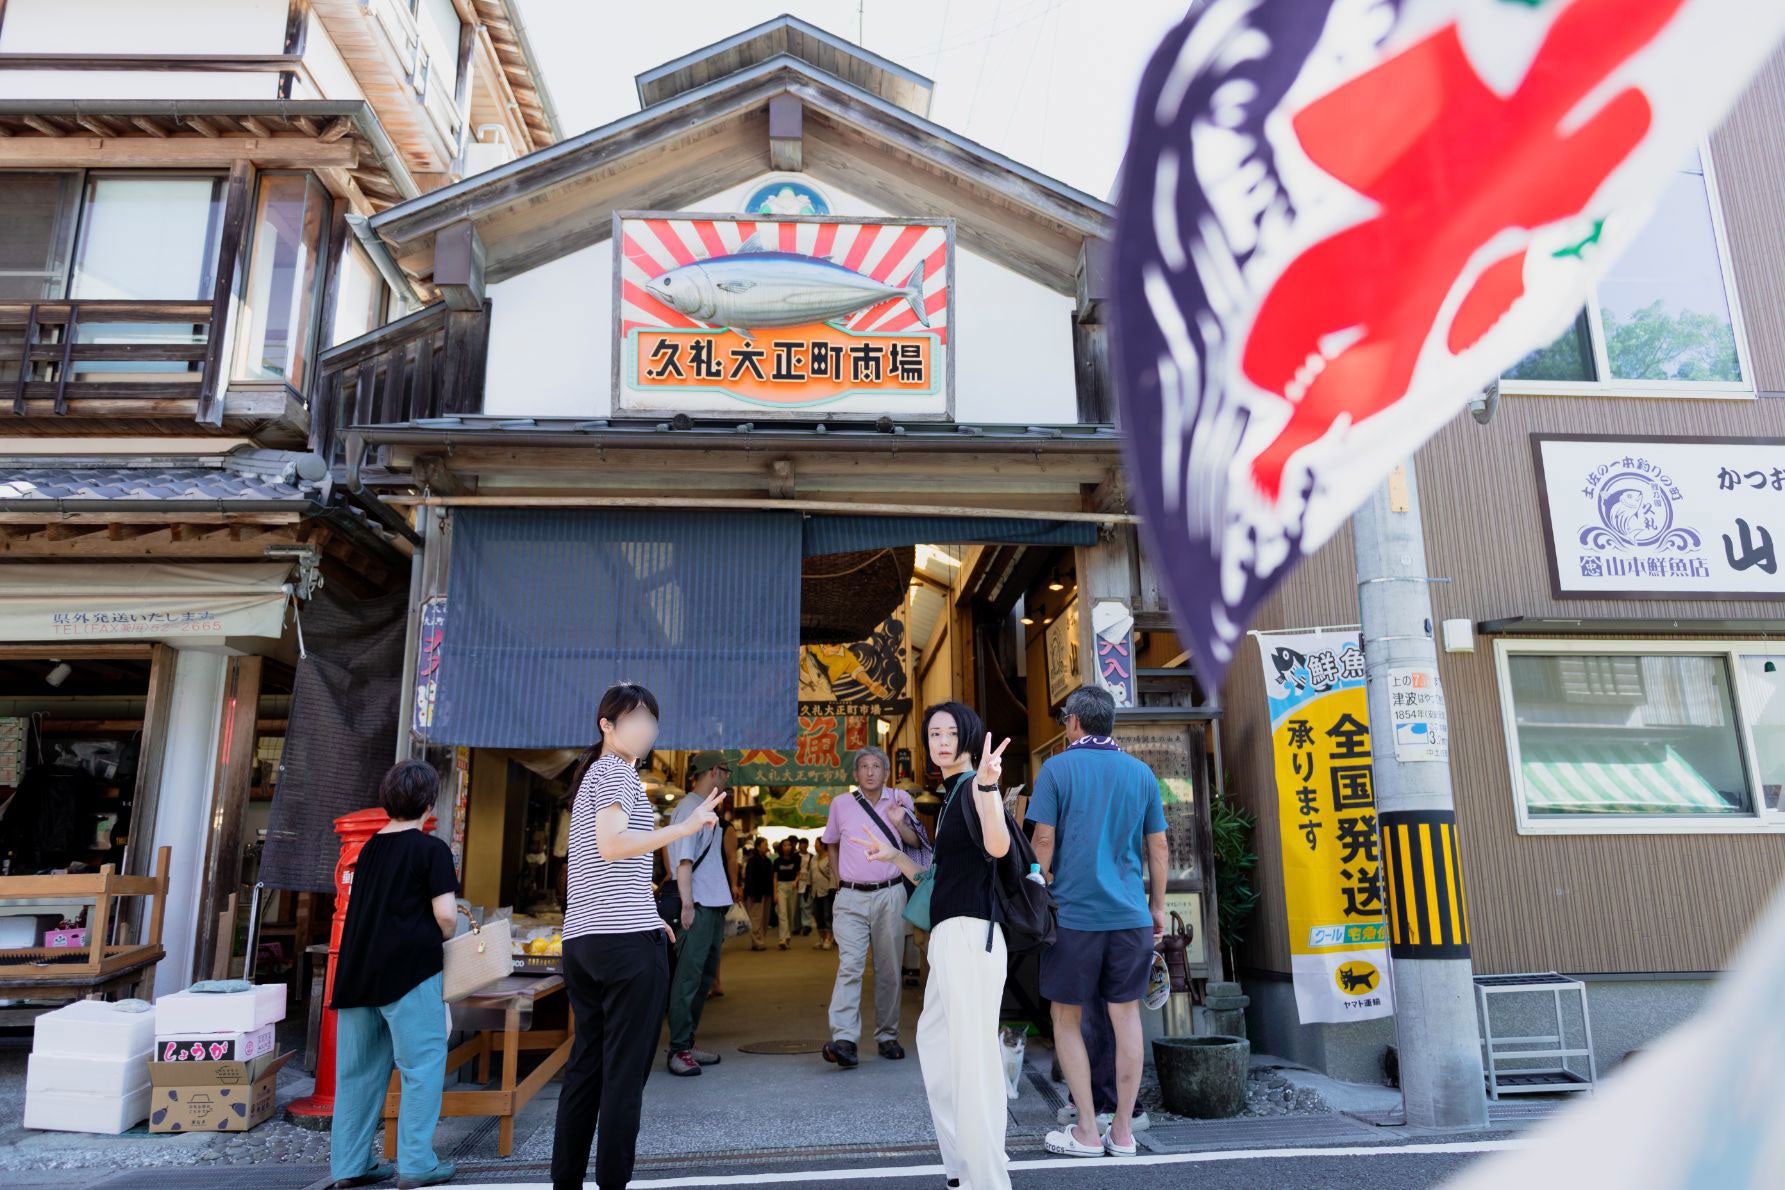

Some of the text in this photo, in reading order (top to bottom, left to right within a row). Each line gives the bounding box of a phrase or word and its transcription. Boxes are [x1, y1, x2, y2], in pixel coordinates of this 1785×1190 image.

[646, 338, 923, 383] 久礼大正町市場
[1581, 456, 1683, 501] 土佐の一本釣りの町
[1642, 503, 1658, 531] 久礼
[1722, 517, 1778, 575] 山
[53, 610, 216, 624] 県外発送いたします
[1287, 719, 1322, 851] 承ります
[1325, 713, 1388, 917] 全国発送
[163, 1041, 229, 1061] しょうが
[1045, 1142, 1065, 1153] crocs
